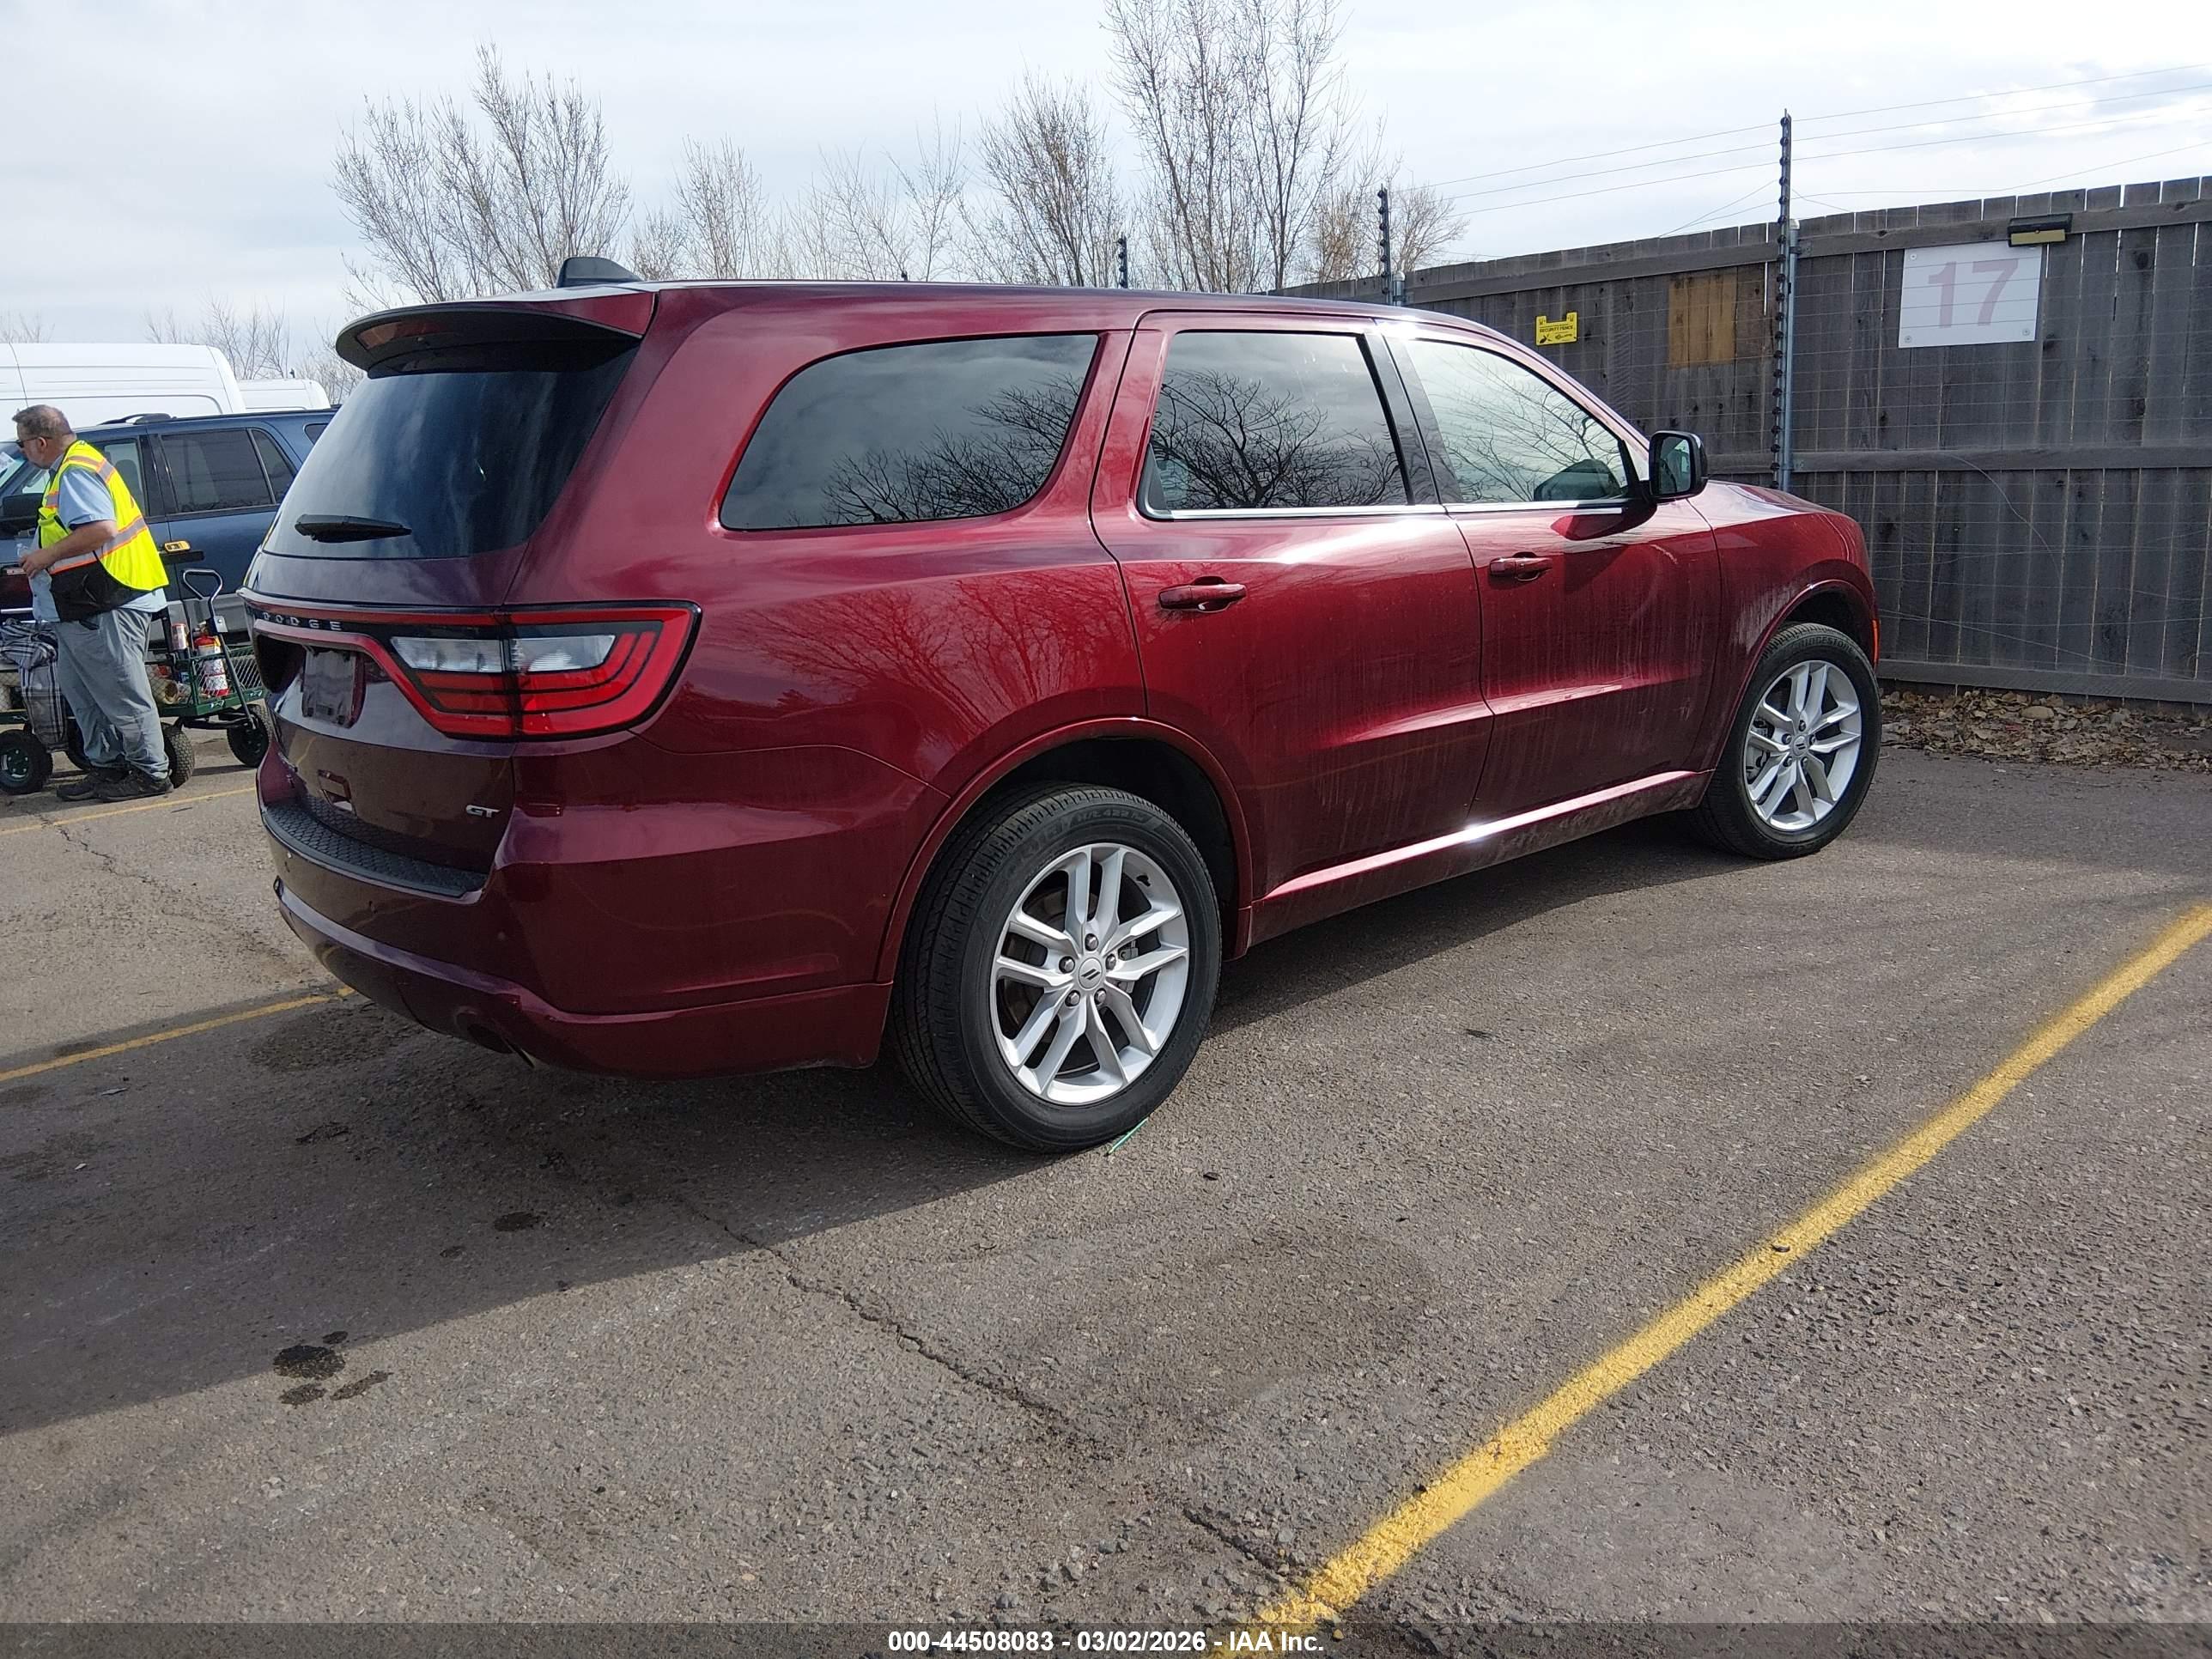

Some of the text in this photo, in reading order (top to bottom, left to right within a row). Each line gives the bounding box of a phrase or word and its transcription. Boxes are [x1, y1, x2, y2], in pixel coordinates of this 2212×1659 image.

[1928, 258, 2019, 328] 17
[262, 611, 343, 631] DODGE
[465, 805, 500, 817] GT
